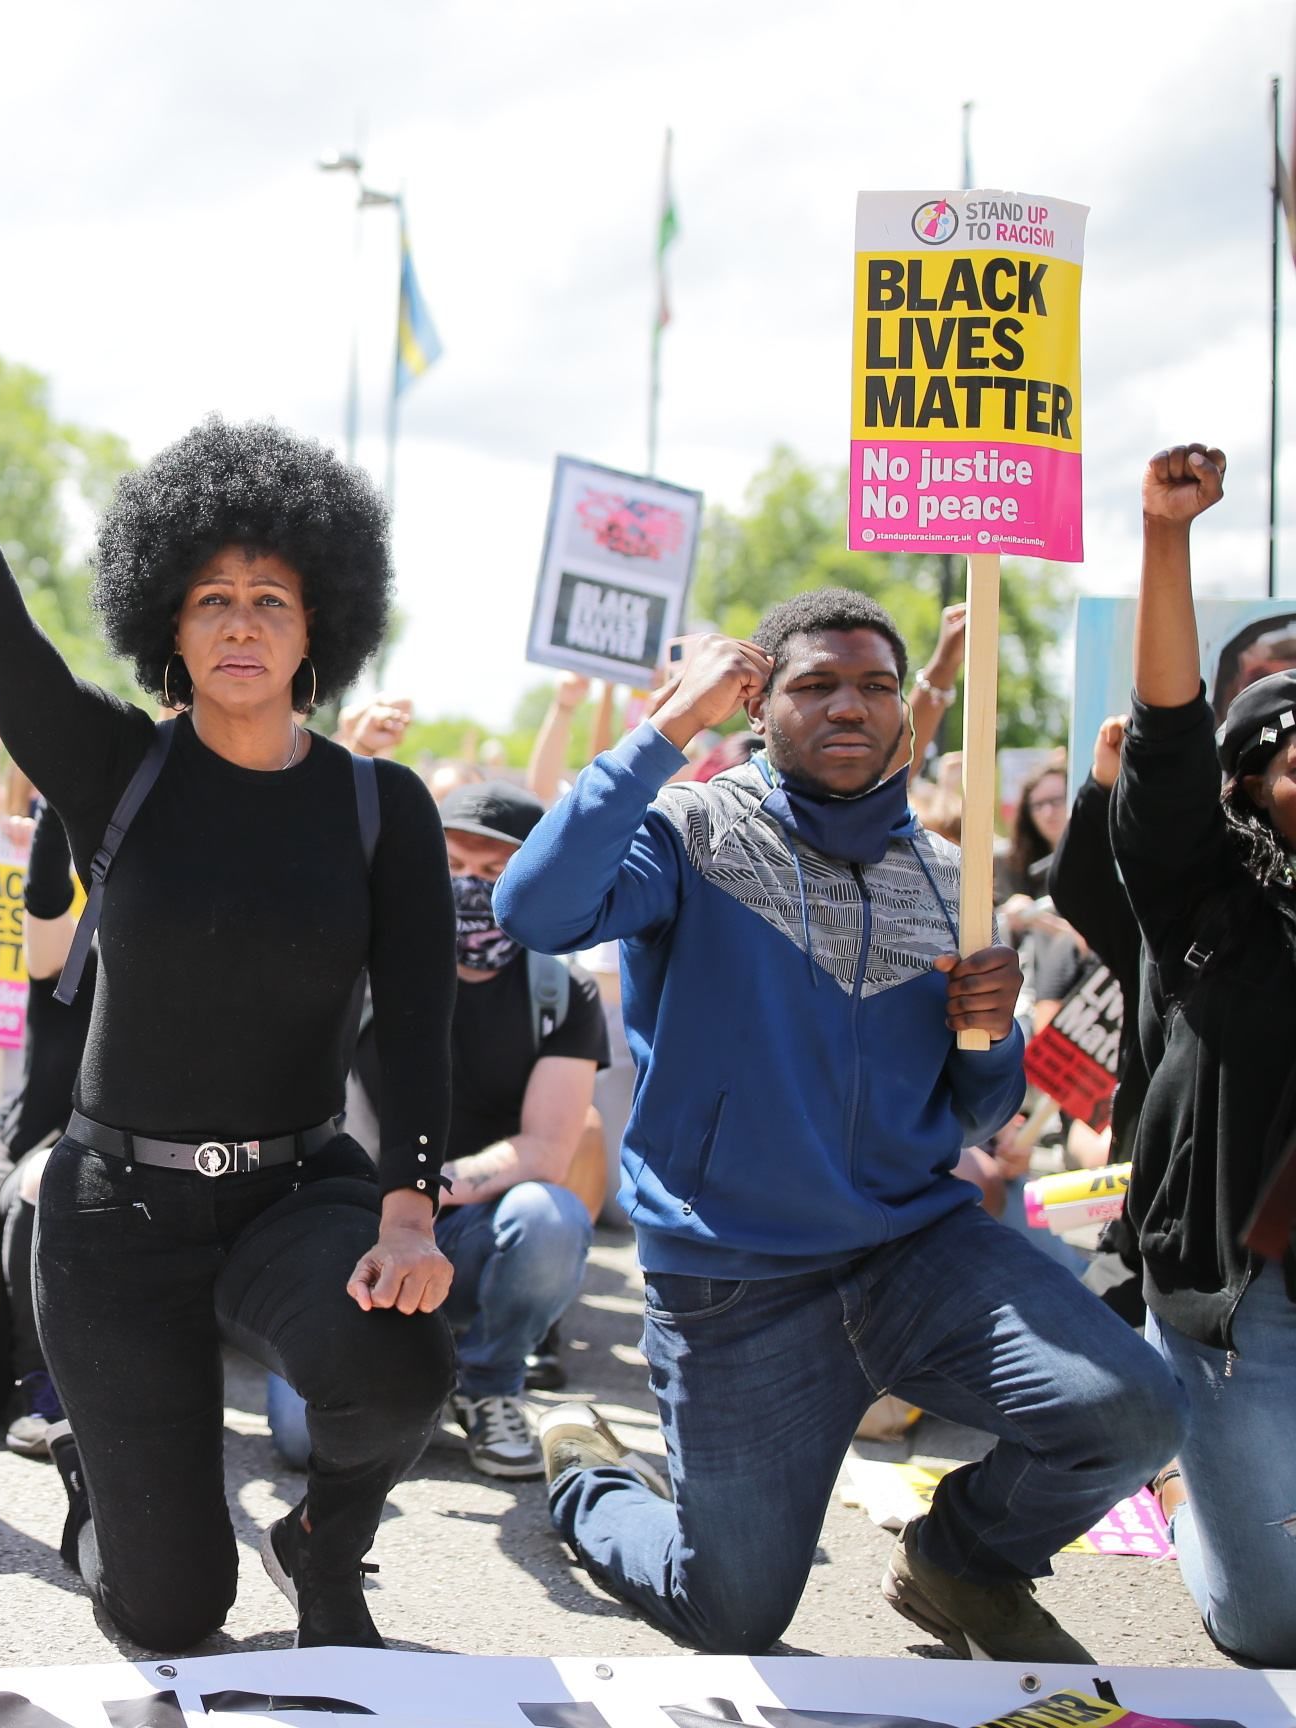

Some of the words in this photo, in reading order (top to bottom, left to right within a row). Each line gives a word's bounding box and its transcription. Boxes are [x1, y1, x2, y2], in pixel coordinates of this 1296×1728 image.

[966, 202, 1023, 222] STAND
[1027, 206, 1049, 225] UP
[965, 223, 991, 241] TO
[996, 223, 1054, 248] RACISM
[867, 258, 1048, 316] BLACK
[865, 316, 1024, 371] LIVES
[864, 375, 1073, 440] MATTER
[862, 448, 910, 481] No
[917, 449, 1033, 489] justice
[861, 485, 909, 519] No
[918, 493, 1019, 528] peace
[876, 532, 972, 543] standuptoracism.org.uk
[991, 534, 1046, 548] @AntiRacismDay
